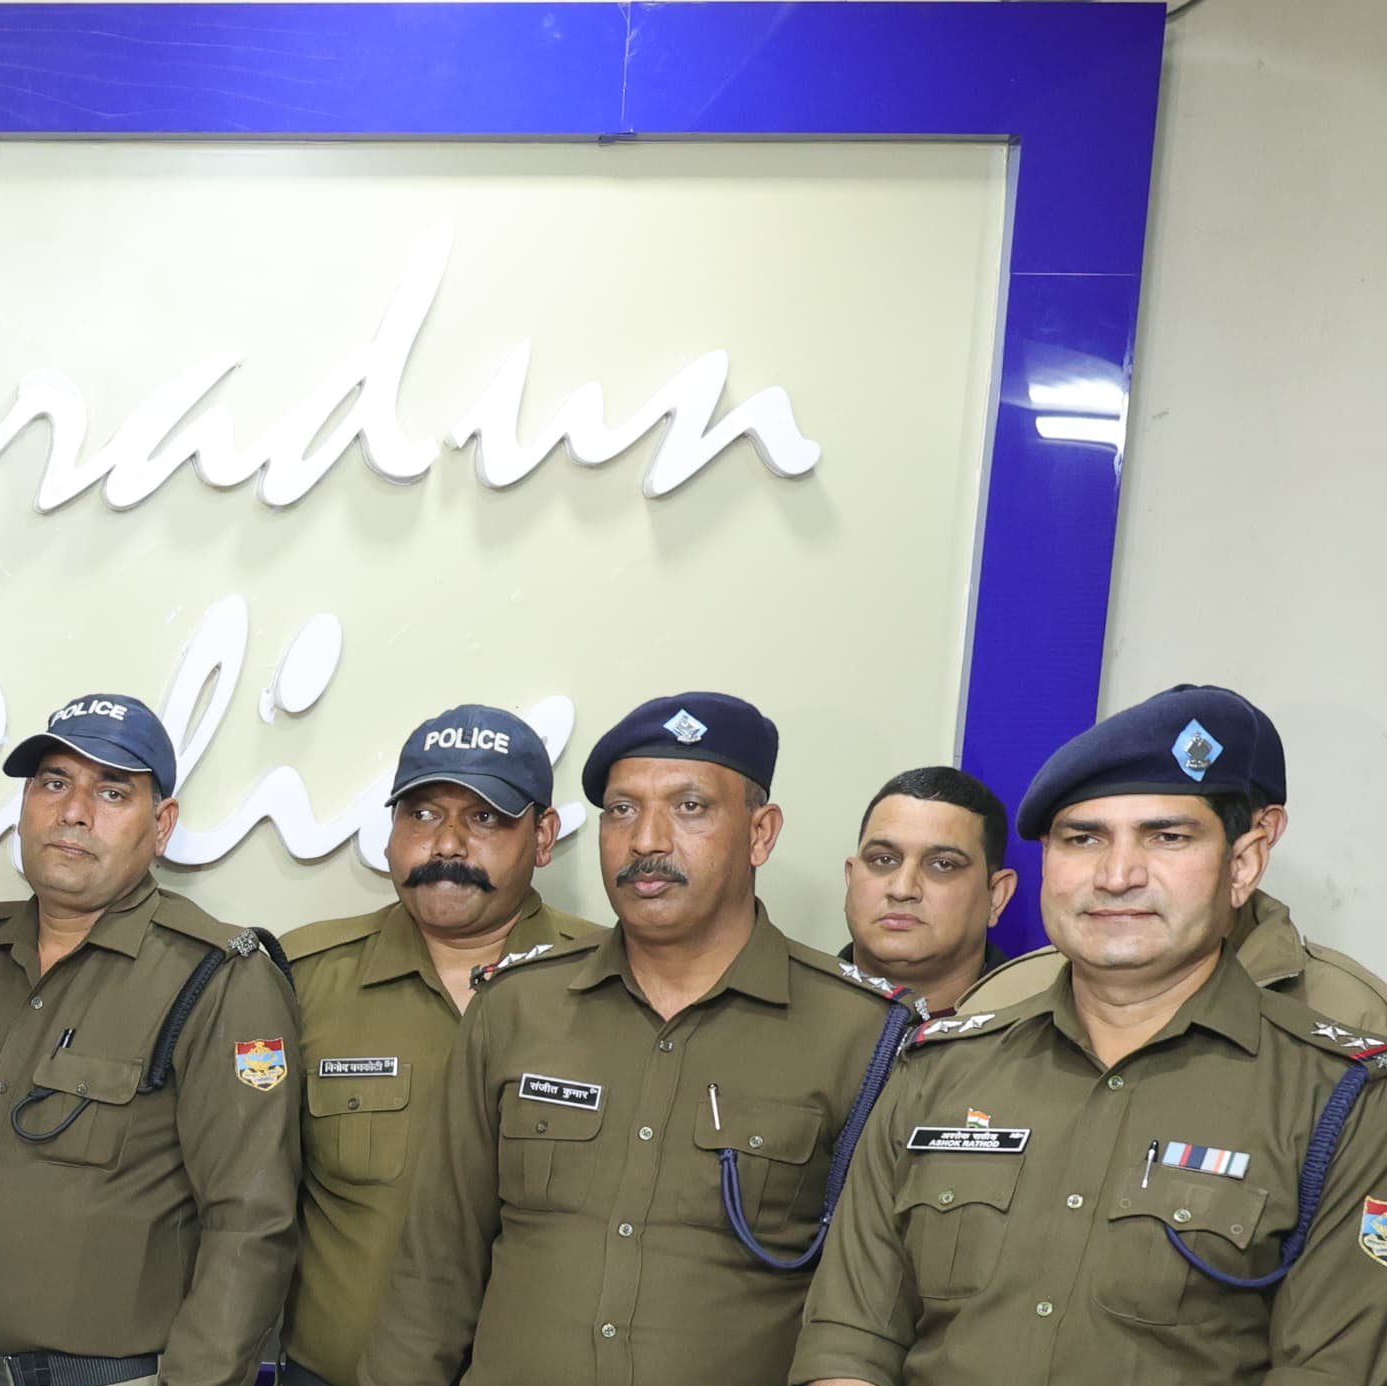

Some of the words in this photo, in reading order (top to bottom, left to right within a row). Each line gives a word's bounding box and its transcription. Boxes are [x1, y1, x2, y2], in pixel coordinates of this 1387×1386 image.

[50, 700, 128, 728] POLICE
[424, 728, 510, 754] POLICE
[529, 1081, 559, 1095] संजीत
[562, 1087, 589, 1100] कुमार
[928, 1139, 962, 1147] ASHOK
[962, 1140, 1000, 1148] RATHOD
